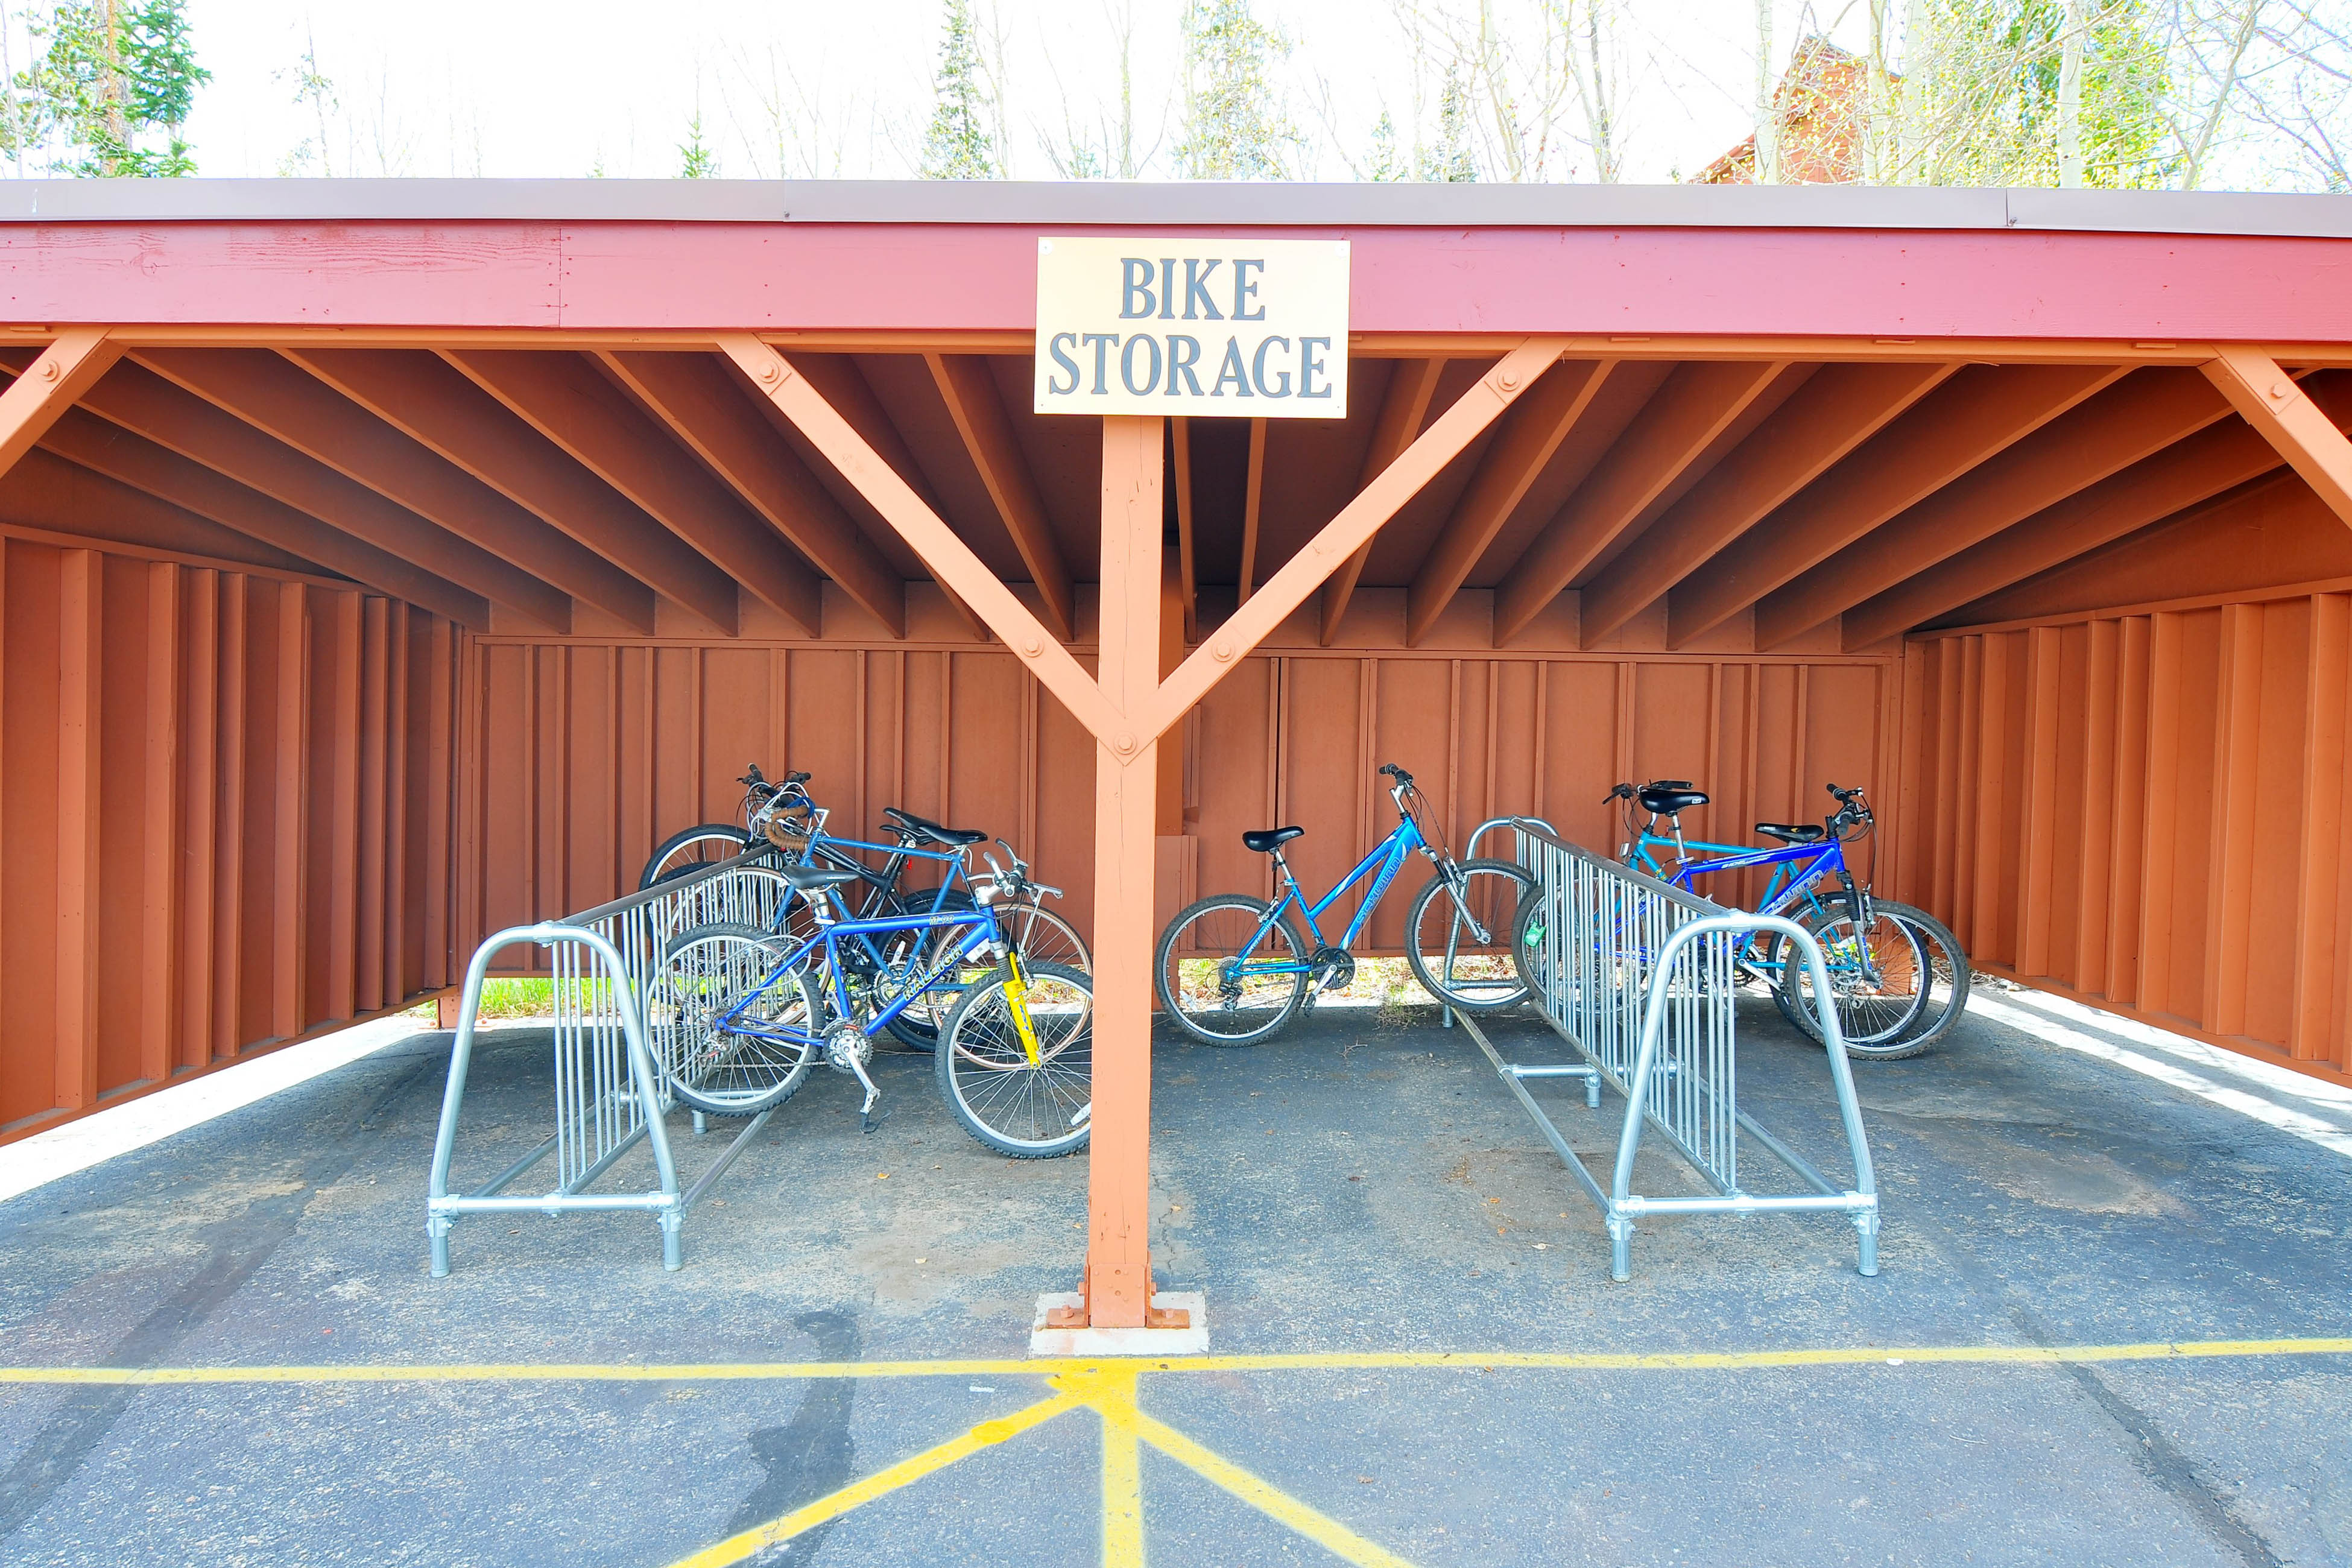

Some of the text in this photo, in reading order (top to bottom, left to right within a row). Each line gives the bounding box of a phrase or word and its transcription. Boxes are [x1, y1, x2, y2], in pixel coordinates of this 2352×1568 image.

[1119, 258, 1265, 321] BIKE
[1049, 332, 1332, 398] STORAGE
[1760, 870, 1824, 915] CHWINN
[903, 944, 964, 1001] RALEIGH
